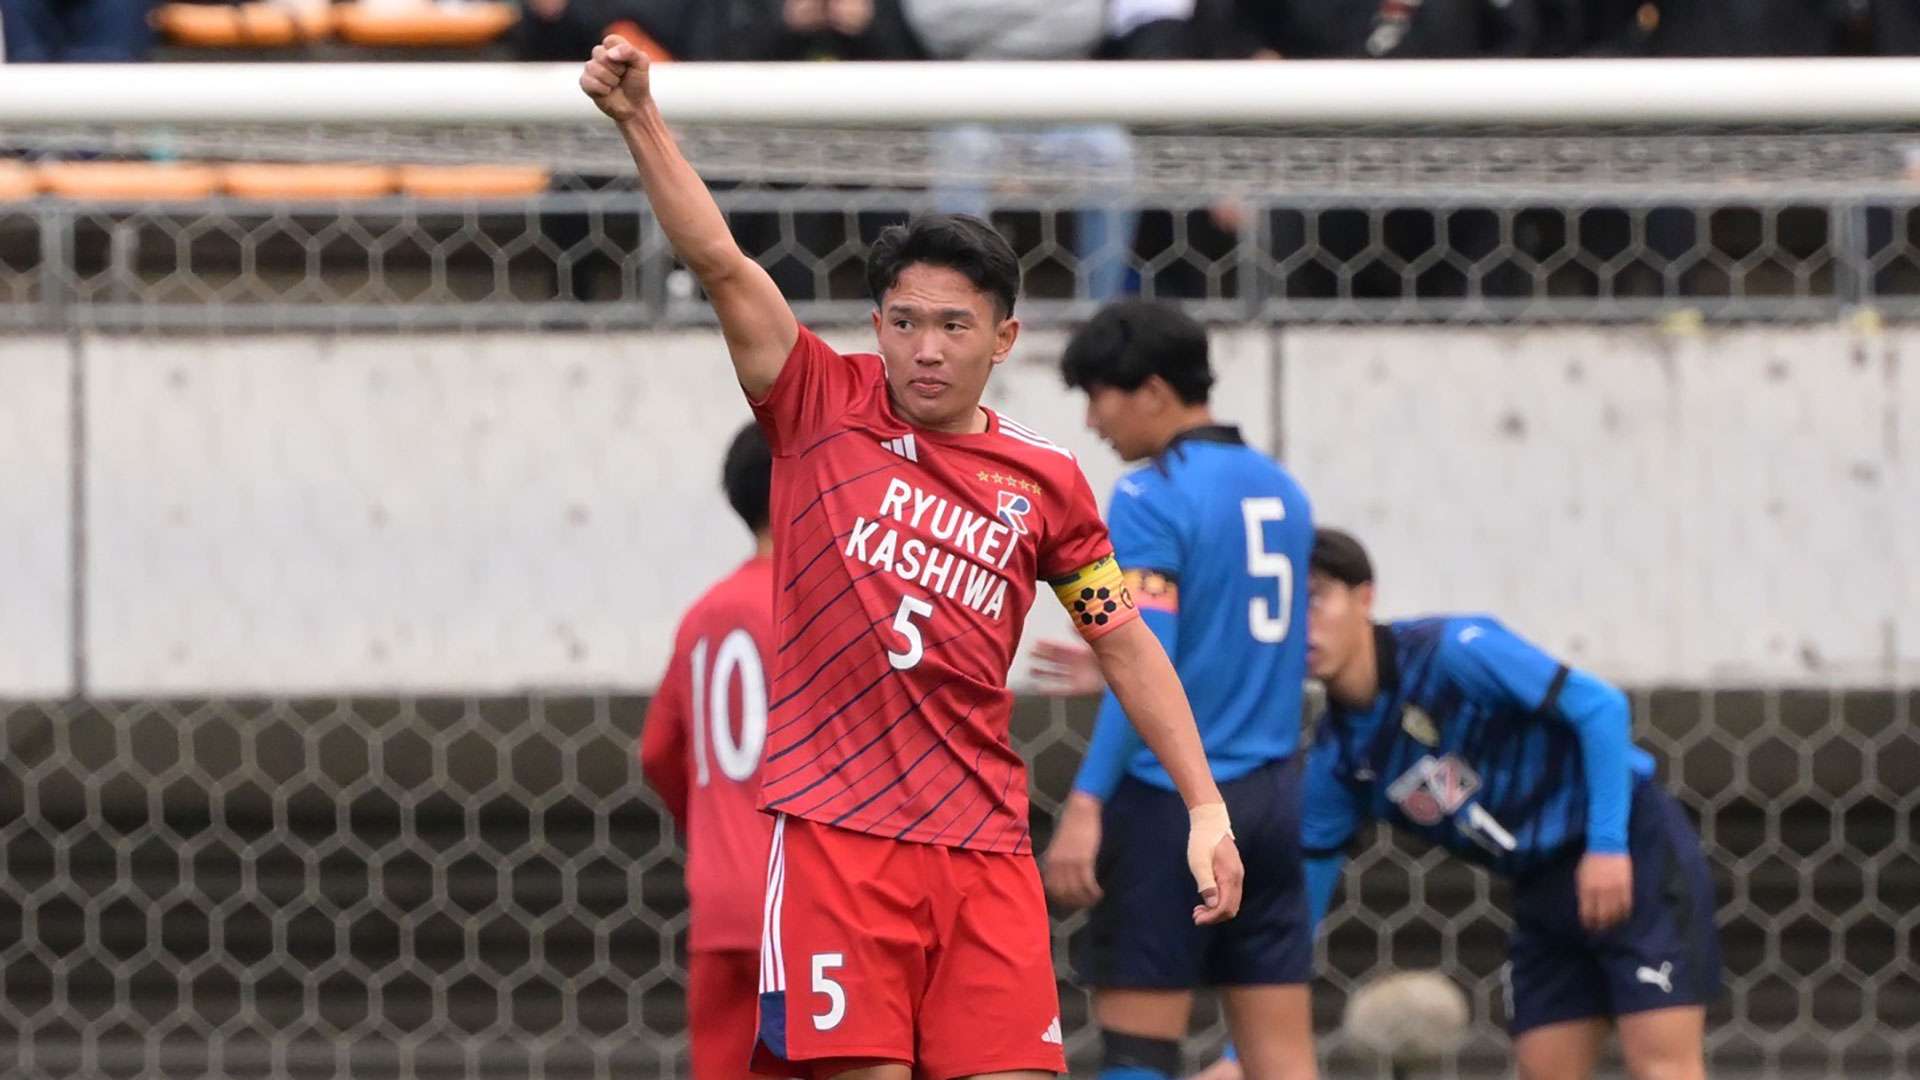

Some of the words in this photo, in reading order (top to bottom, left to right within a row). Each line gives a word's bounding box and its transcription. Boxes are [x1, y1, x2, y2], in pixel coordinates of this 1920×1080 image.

[845, 518, 1009, 621] KASHIWA
[880, 477, 1019, 570] RYUKEI
[1241, 497, 1293, 643] 5
[887, 595, 933, 670] 5
[691, 628, 768, 787] 10
[811, 953, 846, 1031] 5
